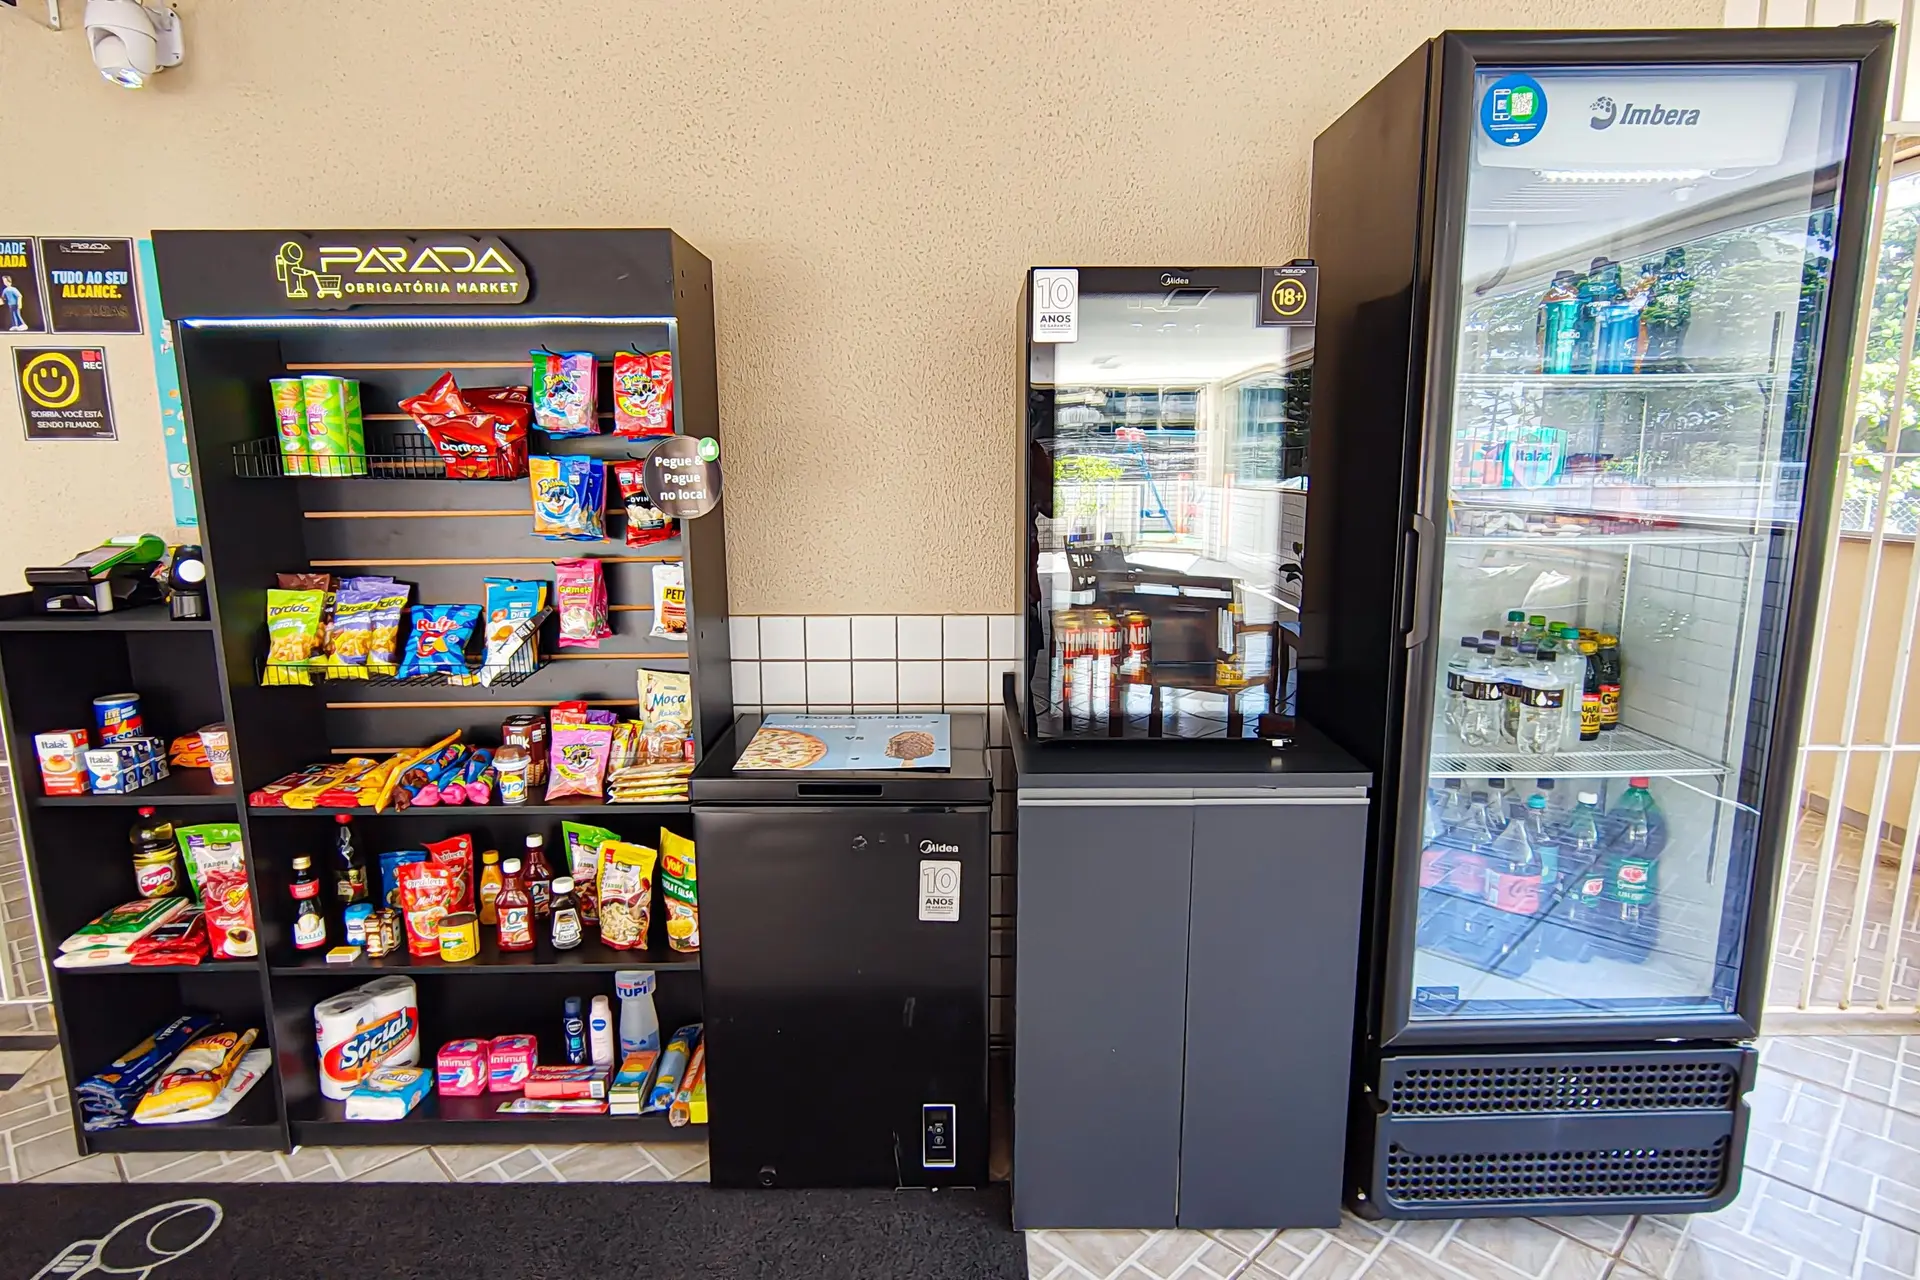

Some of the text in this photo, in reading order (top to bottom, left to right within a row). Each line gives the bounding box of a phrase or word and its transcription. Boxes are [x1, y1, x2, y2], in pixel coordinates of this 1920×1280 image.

[1619, 103, 1700, 125] Imbera
[319, 246, 515, 273] PARADA
[52, 271, 128, 284] TUDO AO SEU
[1160, 273, 1189, 286] Midea
[62, 284, 122, 298] ALCANCE.
[345, 280, 518, 293] OBRIGATÓRIA MARKET
[1036, 277, 1075, 309] 10
[1276, 287, 1304, 306] 18+
[1040, 315, 1071, 323] ANOS
[83, 361, 103, 370] REC
[31, 408, 103, 419] SORRIA, VOCÊ ESTÁ
[37, 420, 102, 429] SENDO FILMADO.
[440, 442, 487, 453] Doritos
[654, 456, 691, 470] Pegue
[664, 473, 701, 486] Pague
[660, 488, 707, 500] no local
[270, 604, 310, 616] Torcida
[510, 610, 531, 619] DIET
[652, 692, 686, 706] Moça
[41, 740, 68, 749] Italac
[920, 840, 958, 853] Midea
[665, 856, 684, 874] Yoki
[140, 871, 171, 888] Soya
[923, 867, 957, 894] 10
[297, 931, 323, 941] GALLO
[617, 986, 647, 997] TUPI
[340, 1007, 409, 1069] Social
